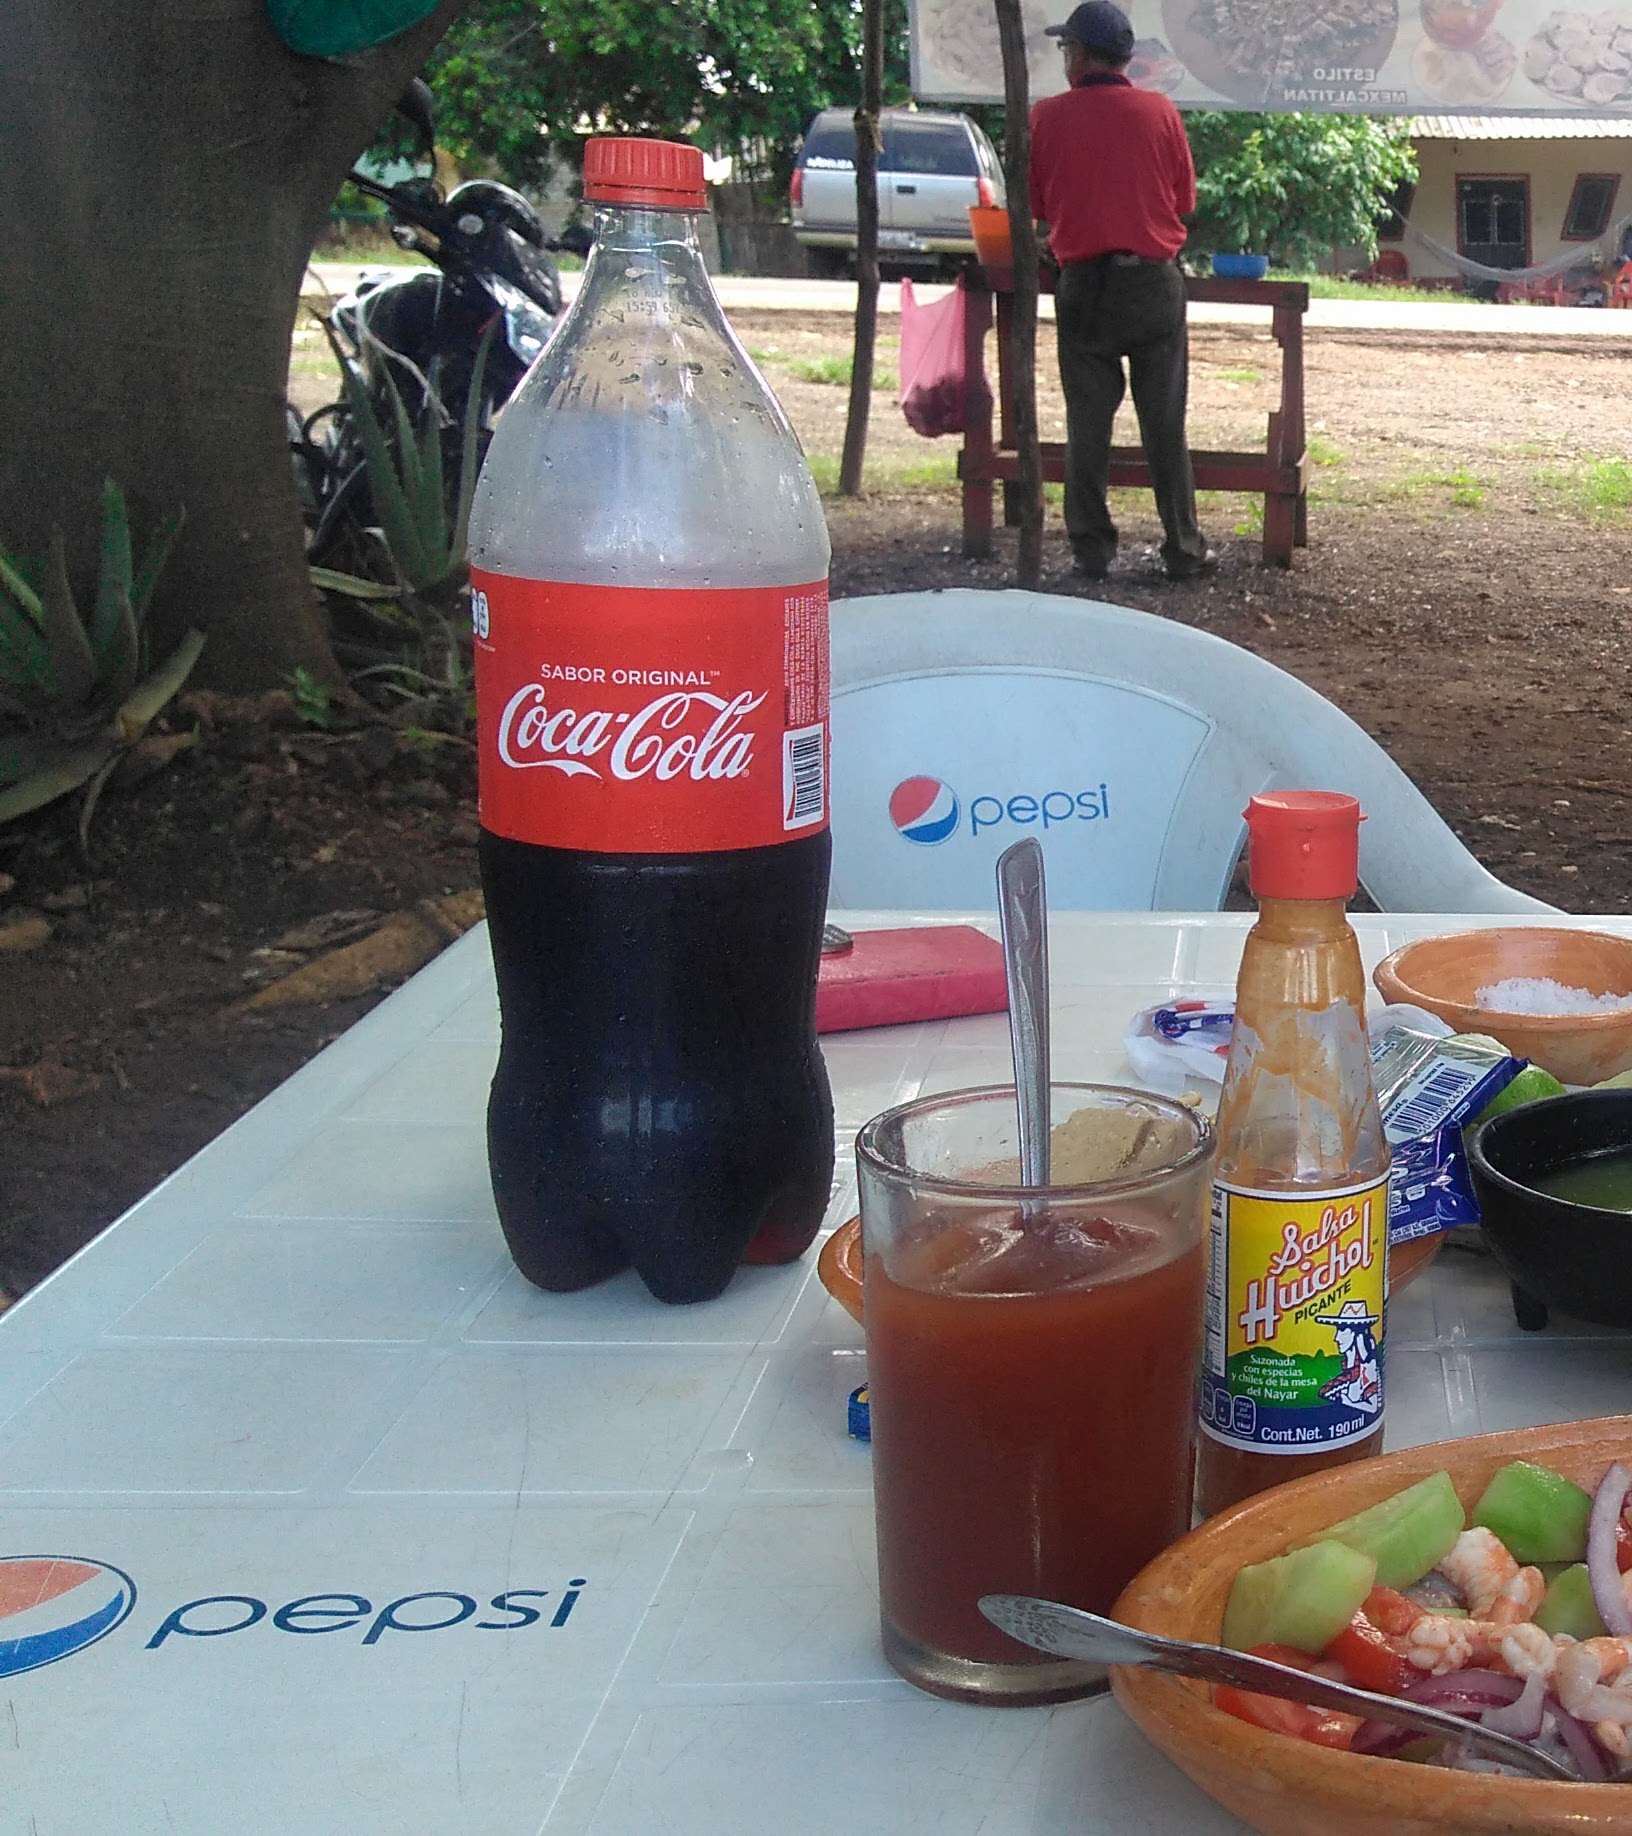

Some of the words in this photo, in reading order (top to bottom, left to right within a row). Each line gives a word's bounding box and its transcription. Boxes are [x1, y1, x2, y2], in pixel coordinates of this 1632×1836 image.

[541, 663, 606, 683] SABOR
[498, 683, 770, 781] Coca-Cola
[971, 783, 1109, 837] pepsi
[1271, 1206, 1358, 1275] Salsa
[1239, 1199, 1373, 1345] Huichol
[1294, 1278, 1352, 1325] PICANTE
[1243, 1365, 1260, 1374] con
[1261, 1367, 1303, 1377] especias
[1250, 1354, 1296, 1366] Sazonada
[1231, 1372, 1237, 1381] y
[1238, 1372, 1264, 1385] chiles
[1265, 1377, 1278, 1386] de
[1280, 1377, 1289, 1386] la
[1291, 1378, 1318, 1387] mesa
[1246, 1386, 1261, 1396] del
[1264, 1388, 1299, 1401] Nayar
[1328, 1420, 1351, 1438] 190
[1351, 1414, 1365, 1431] ml
[144, 1577, 588, 1650] pepsi
